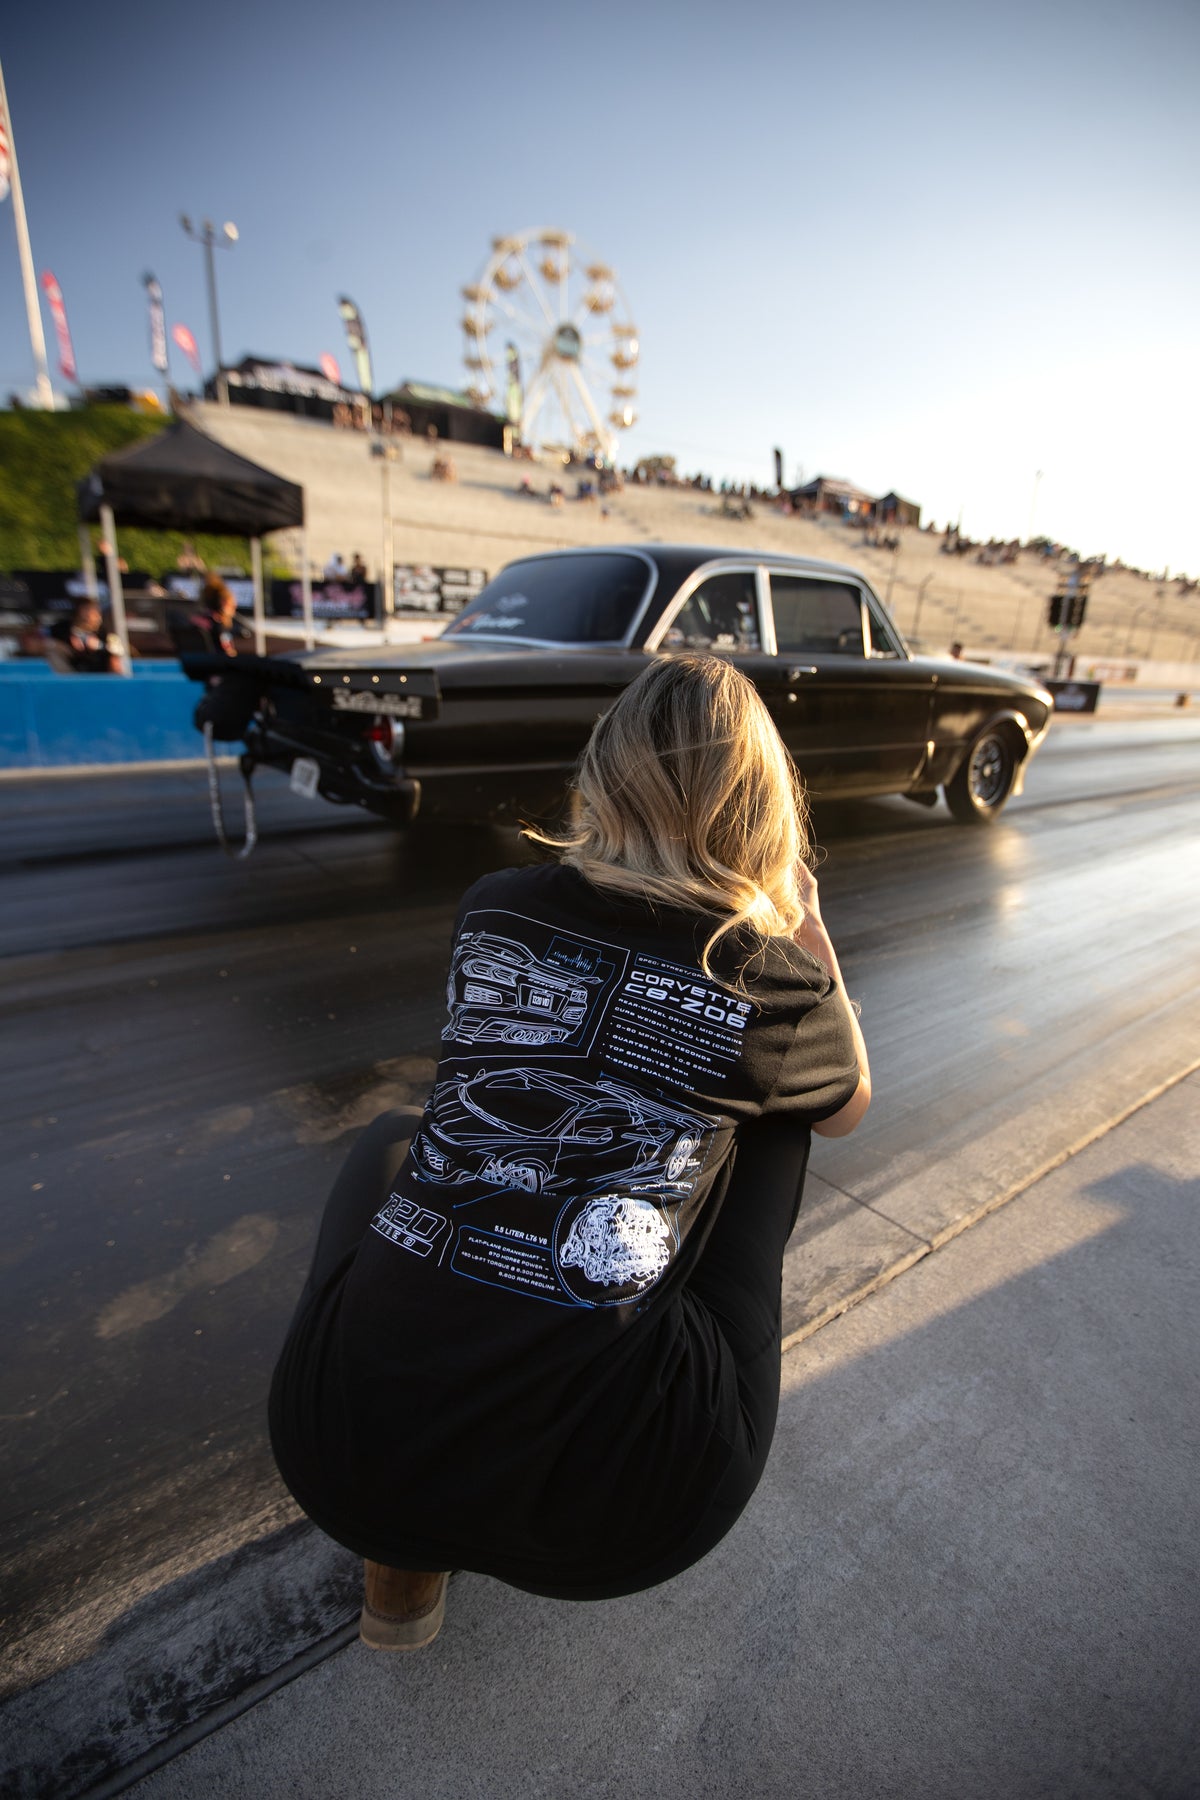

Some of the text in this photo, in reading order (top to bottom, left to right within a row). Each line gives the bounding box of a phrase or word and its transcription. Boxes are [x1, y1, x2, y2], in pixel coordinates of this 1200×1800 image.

[638, 957, 659, 966] SPEC:
[624, 982, 747, 1029] C8-Z06
[630, 970, 752, 1013] CORVETTE
[614, 1006, 635, 1016] CURB
[637, 1014, 669, 1030] WEIGHT:
[695, 1036, 710, 1045] LBS
[711, 1042, 742, 1057] (COUPE)
[618, 998, 743, 1045] REAR-WHEEL DRIVE MID-ENGINE
[609, 1044, 624, 1053] TOP
[672, 1066, 689, 1077] MPH
[612, 1034, 649, 1050] QUARTER
[650, 1047, 672, 1058] MILE:
[692, 1063, 727, 1079] SECONDS
[638, 1031, 658, 1042] MPH:
[674, 1045, 712, 1062] SECONDS
[641, 1066, 695, 1091] DUAL-CLUTCH
[468, 1236, 540, 1260] FLAT-PLANE CRANKSHAFT
[494, 1225, 548, 1245] 5.5 LITER LT6 V8
[487, 1258, 510, 1270] TORQUE
[535, 1272, 549, 1281] RPM
[501, 1254, 520, 1264] HORSE
[522, 1260, 543, 1270] POWER
[516, 1276, 530, 1284] RPM
[531, 1280, 555, 1291] REDLINE
